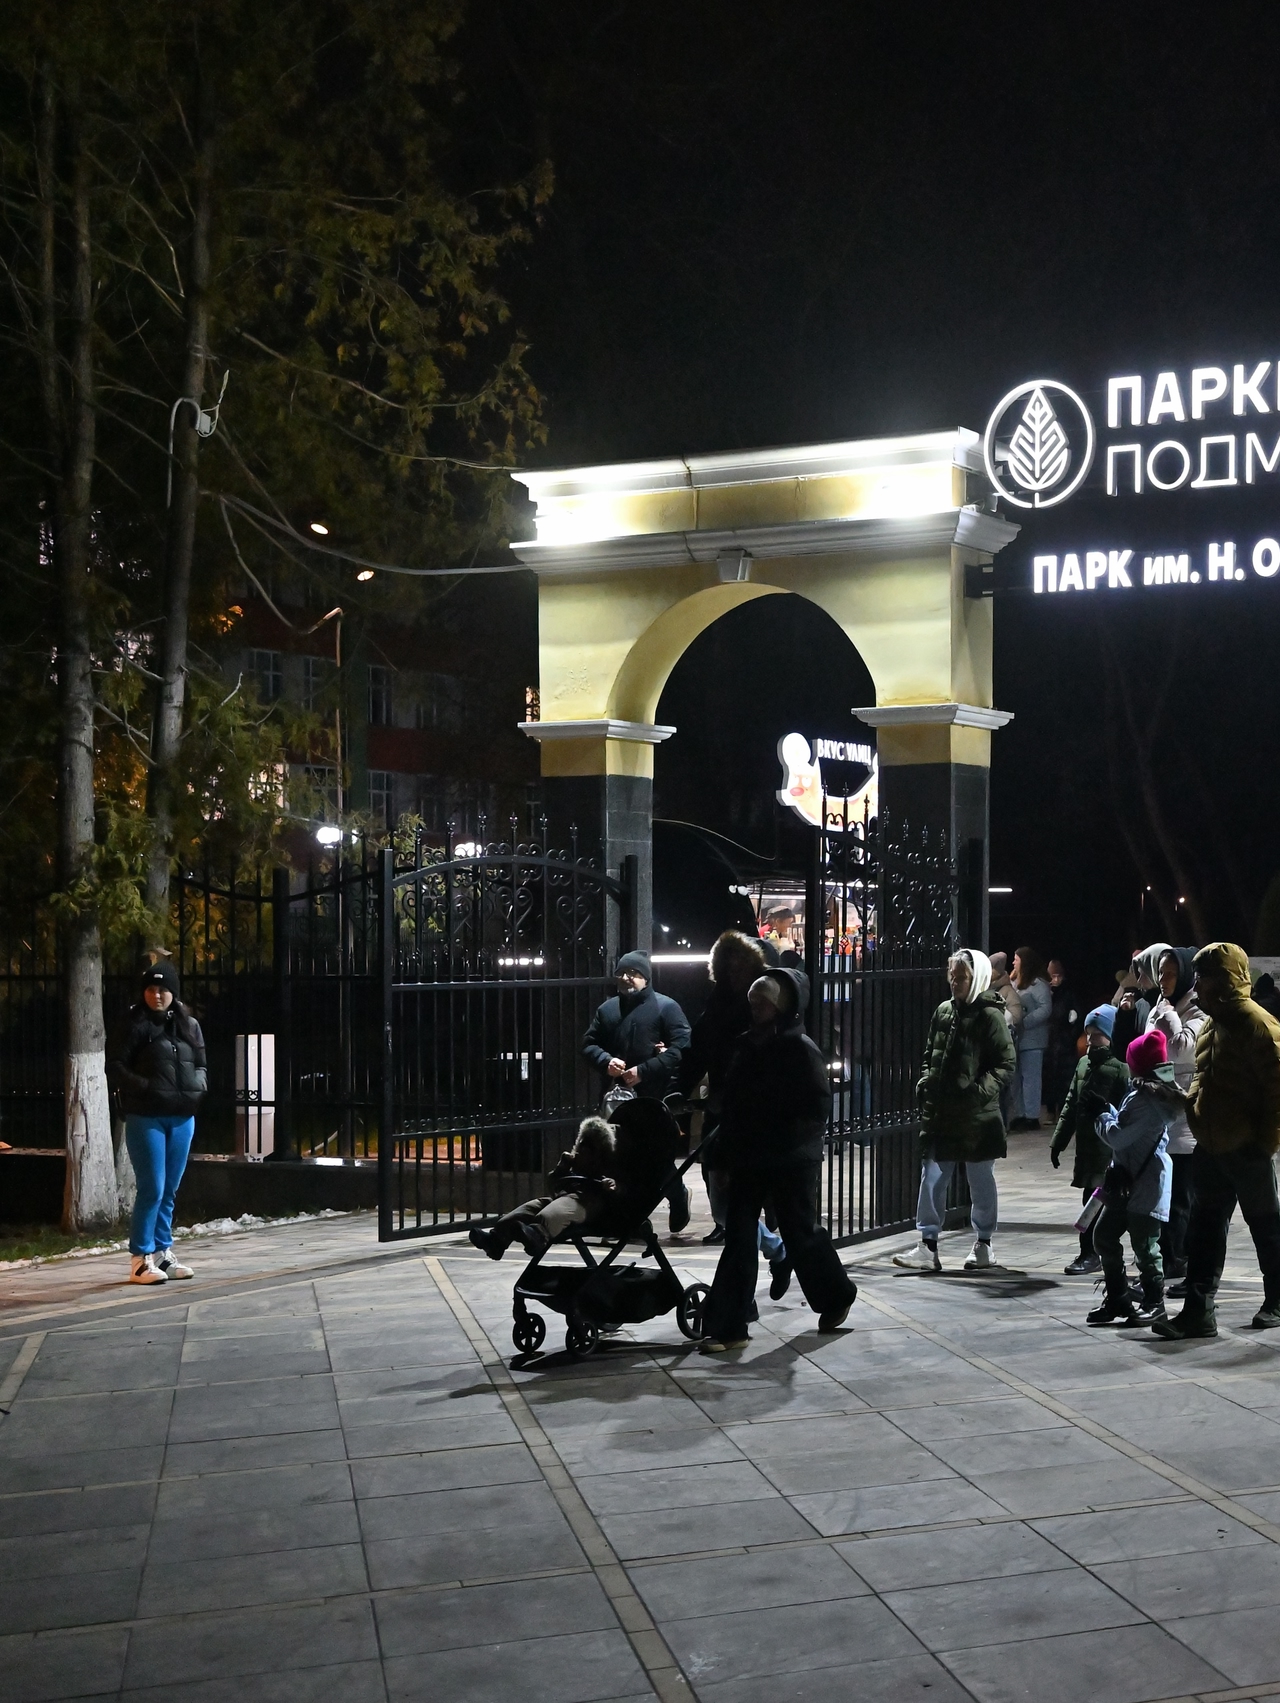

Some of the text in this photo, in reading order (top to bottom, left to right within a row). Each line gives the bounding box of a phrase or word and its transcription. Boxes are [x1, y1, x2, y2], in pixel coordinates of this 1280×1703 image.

[1033, 549, 1134, 594] ПАРК
[1208, 542, 1245, 582] Н.
[817, 738, 872, 766] ВКУС УЛИЦ
